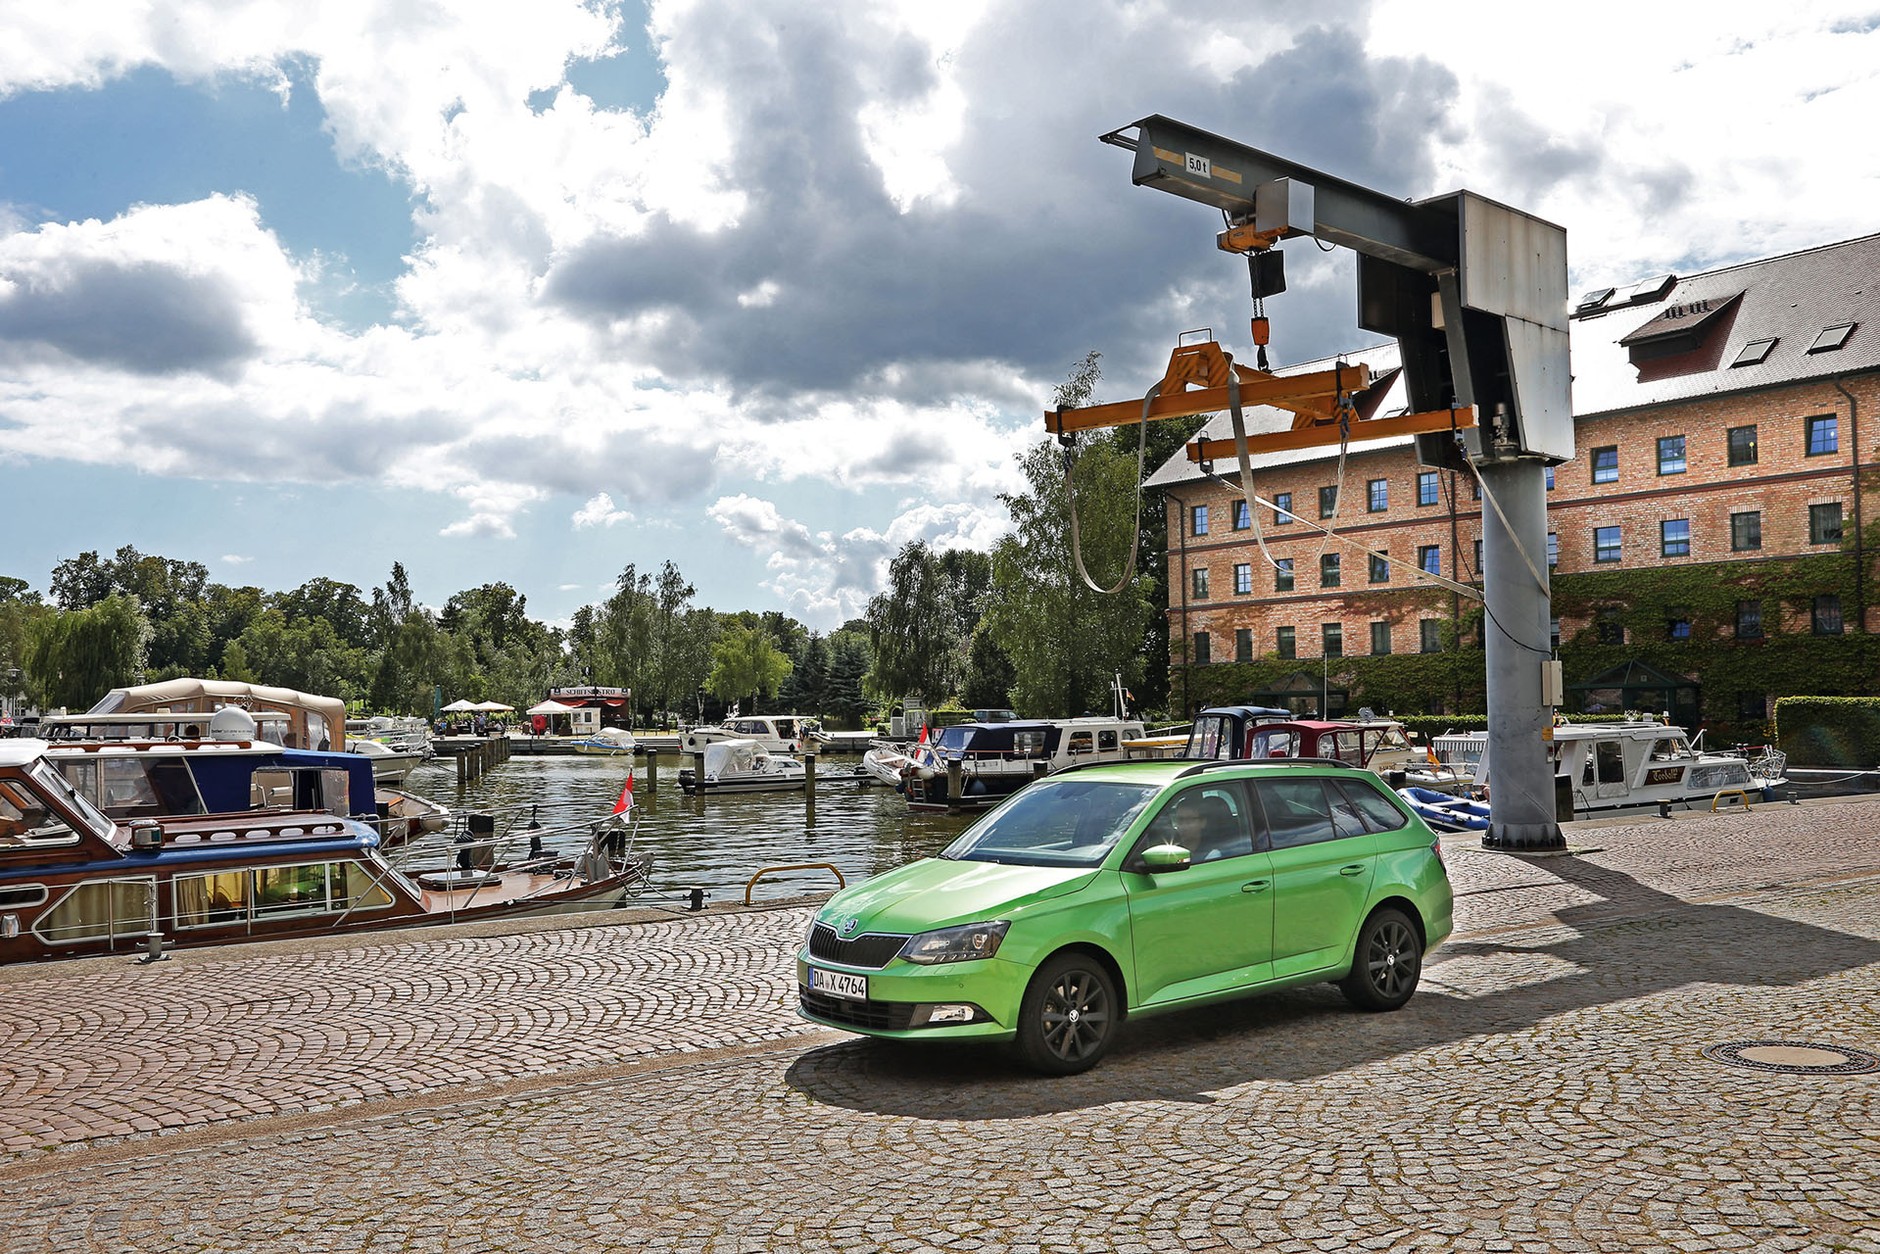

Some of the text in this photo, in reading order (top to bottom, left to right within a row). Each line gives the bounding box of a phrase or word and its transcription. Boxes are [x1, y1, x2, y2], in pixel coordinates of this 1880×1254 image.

[813, 970, 825, 989] DA
[830, 974, 837, 991] X
[838, 976, 865, 996] 4764
